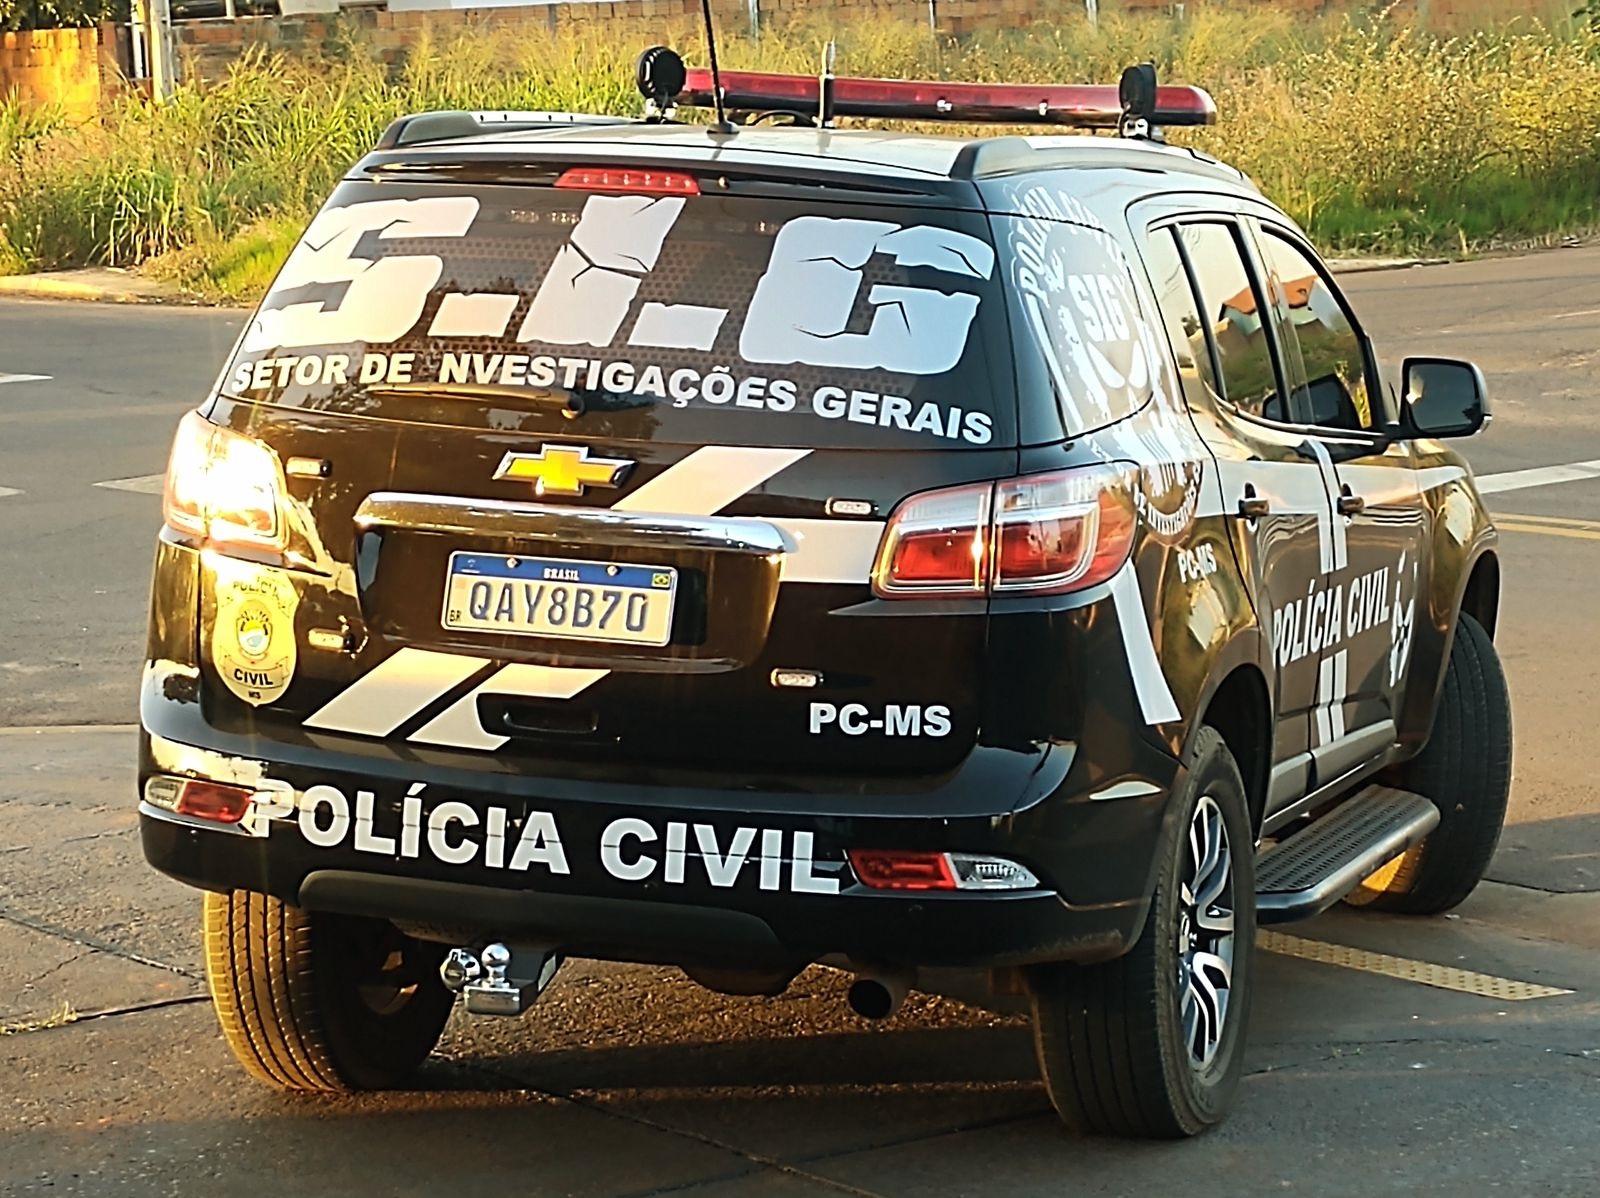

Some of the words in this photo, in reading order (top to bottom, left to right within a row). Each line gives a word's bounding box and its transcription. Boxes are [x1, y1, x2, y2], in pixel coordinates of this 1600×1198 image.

[1067, 274, 1130, 342] SIG
[231, 354, 347, 393] SETOR
[357, 352, 414, 385] DE
[438, 352, 798, 413] NVESTIGAÇÕES
[812, 385, 994, 446] GERAIS
[543, 567, 580, 582] BRASIL
[1176, 543, 1218, 584] PC-MS
[449, 609, 462, 623] BR
[469, 580, 650, 633] QAY8B70
[1272, 578, 1343, 669] POLÍCIA
[1346, 566, 1391, 639] CIVIL
[233, 668, 274, 687] CIVIL
[809, 702, 952, 737] PC-MS
[254, 779, 572, 876] POLÍCIA
[599, 815, 842, 896] CIVIL
